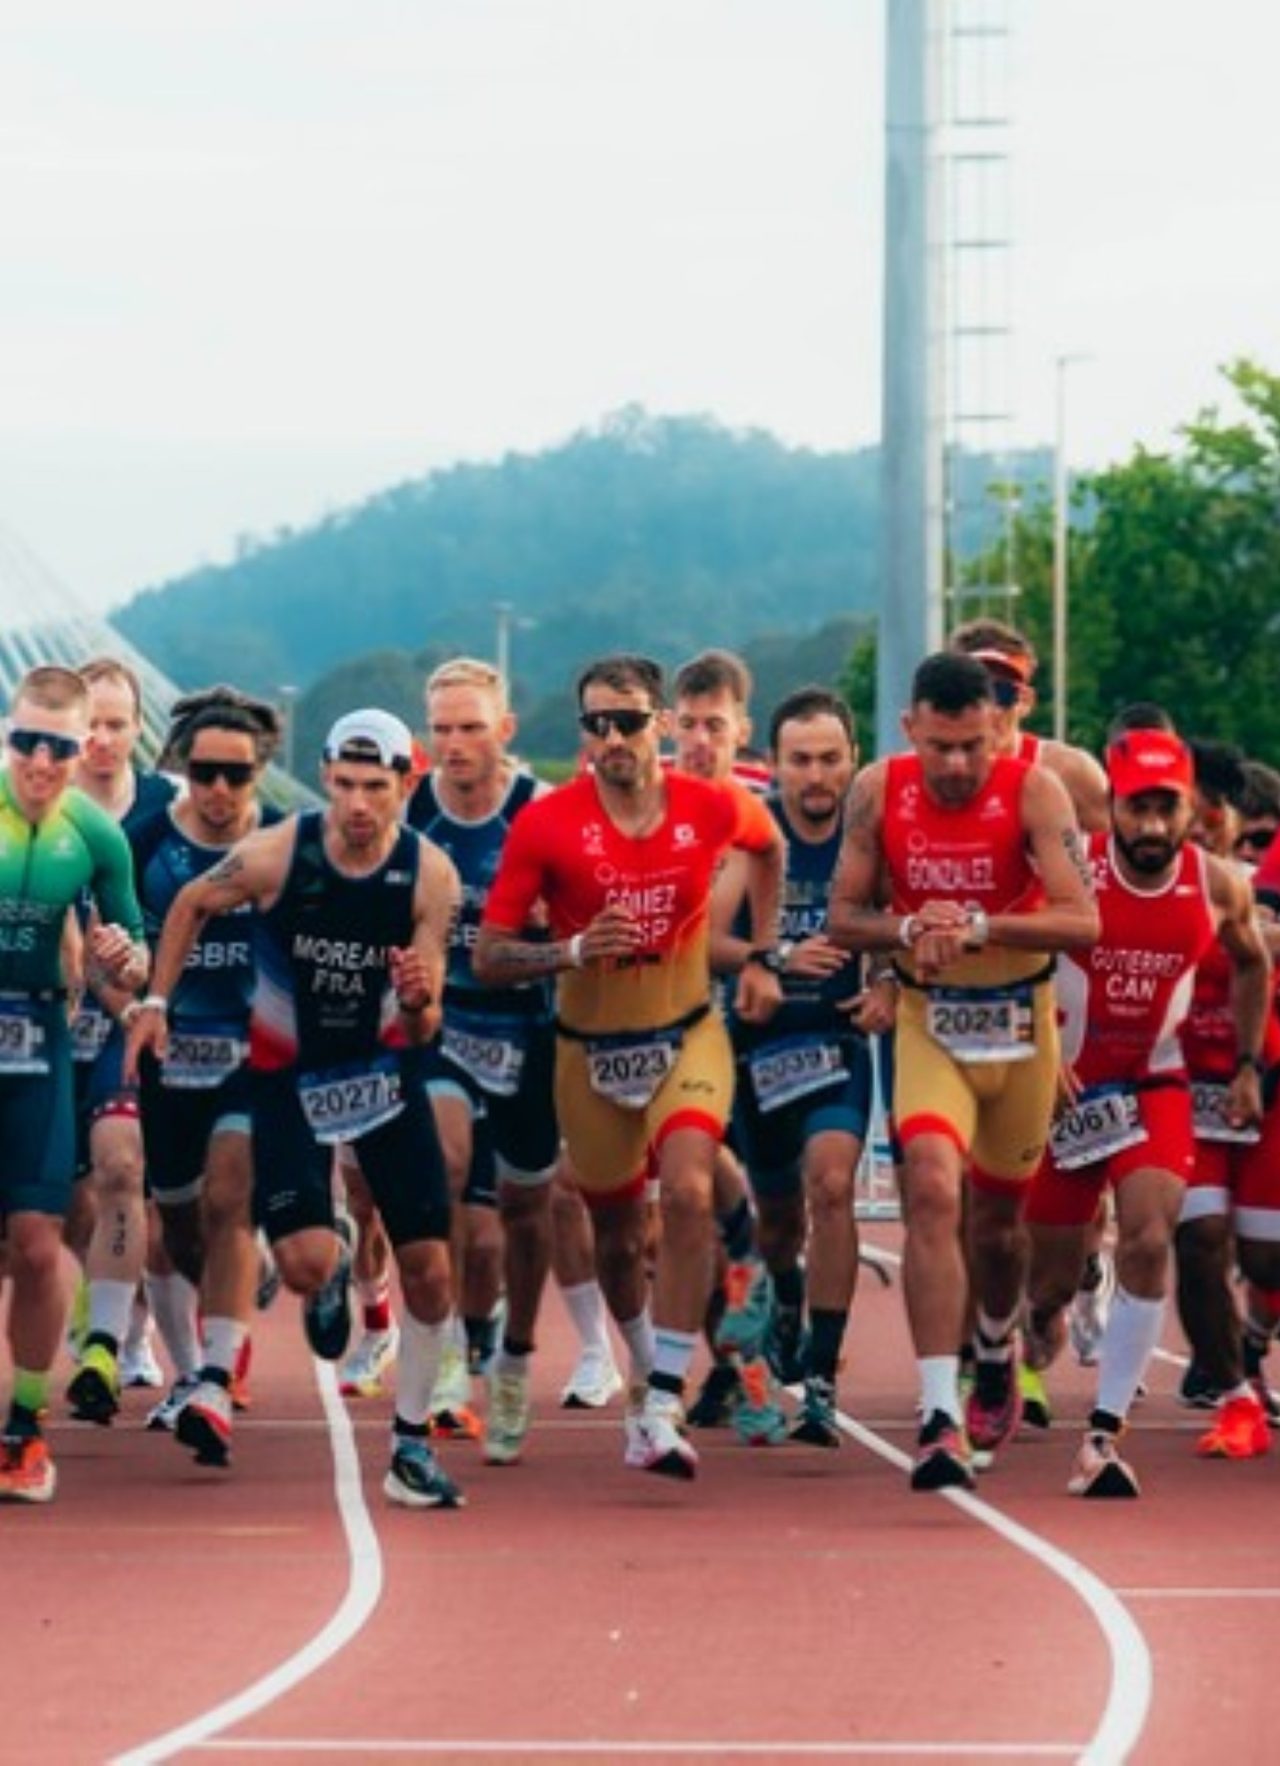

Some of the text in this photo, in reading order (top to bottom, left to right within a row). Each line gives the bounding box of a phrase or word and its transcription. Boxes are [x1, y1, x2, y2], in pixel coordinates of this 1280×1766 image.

[311, 968, 366, 996] FRA
[1105, 972, 1158, 1001] CAN
[933, 1008, 1011, 1034] 2024
[595, 1050, 668, 1082] 2023
[306, 1080, 382, 1117] 2027
